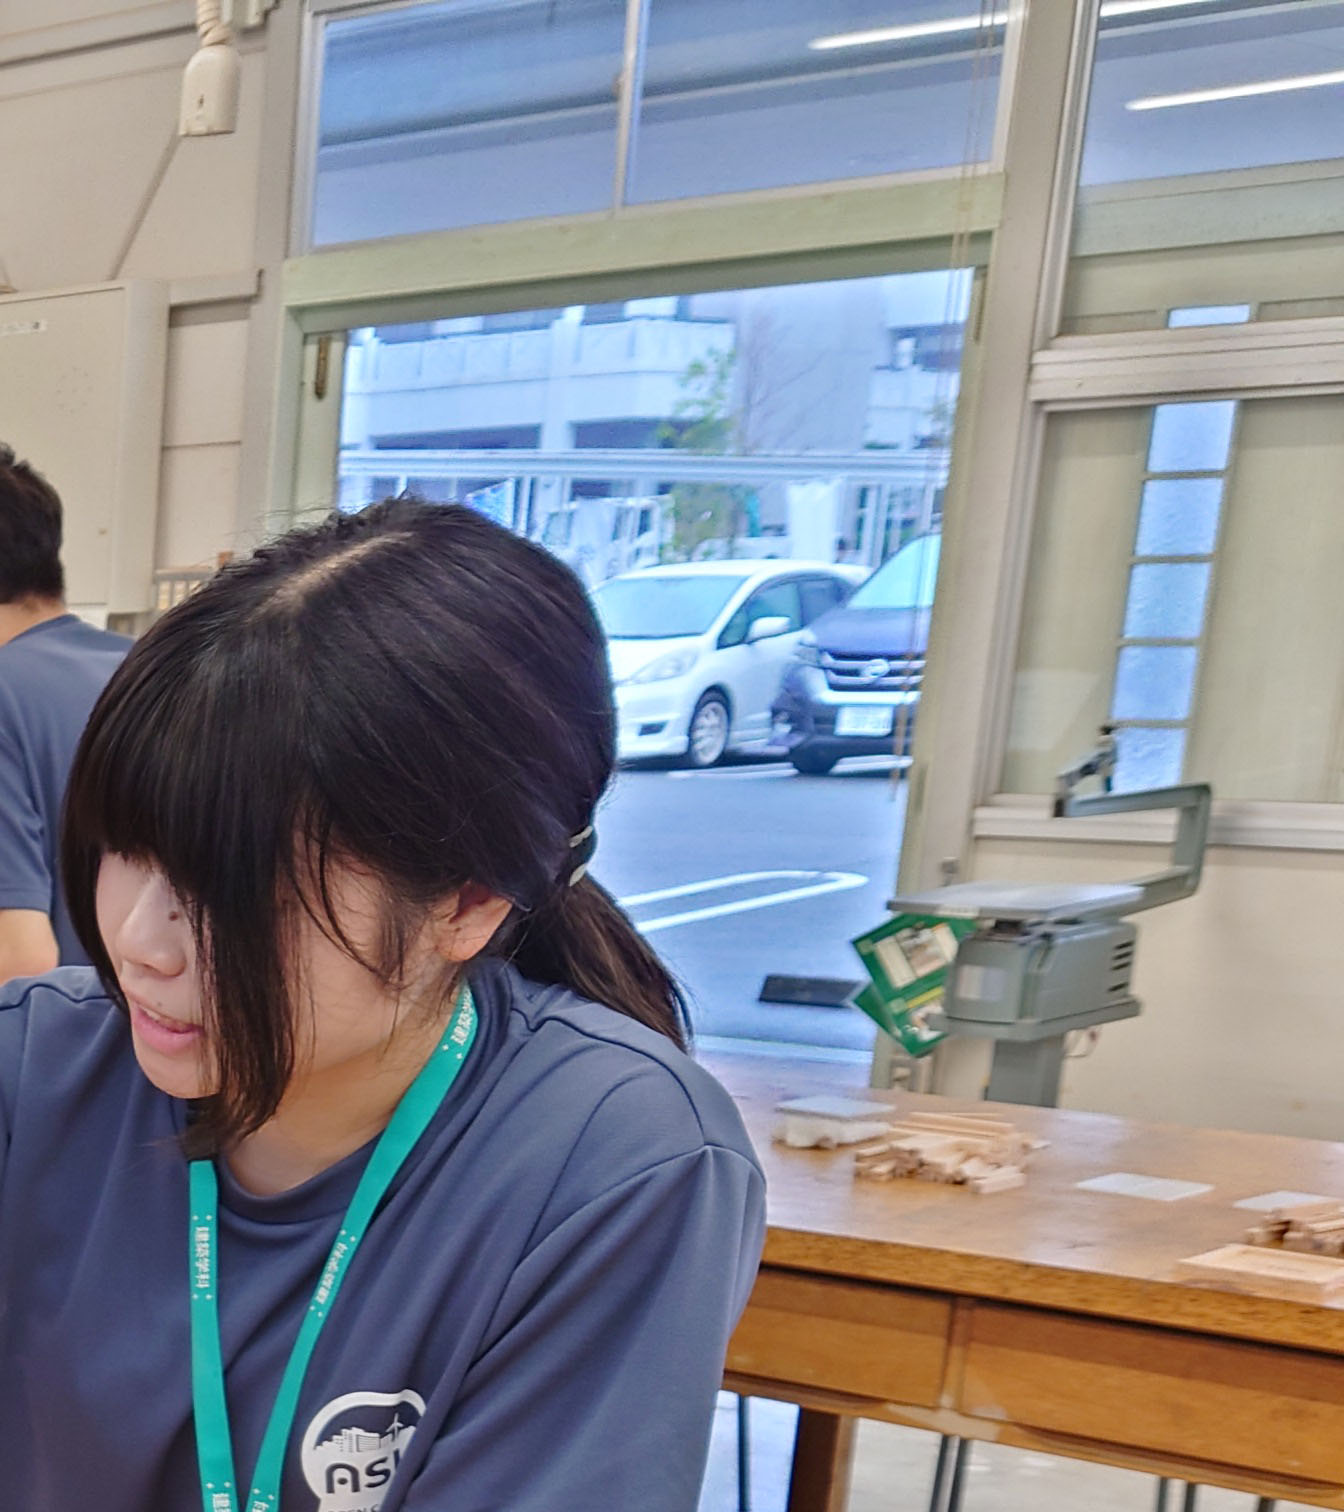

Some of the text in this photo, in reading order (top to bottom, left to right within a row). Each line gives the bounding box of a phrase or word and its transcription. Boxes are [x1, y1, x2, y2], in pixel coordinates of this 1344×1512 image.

[195, 1226, 210, 1288] 建築学科
[316, 1242, 348, 1304] 建築学科
